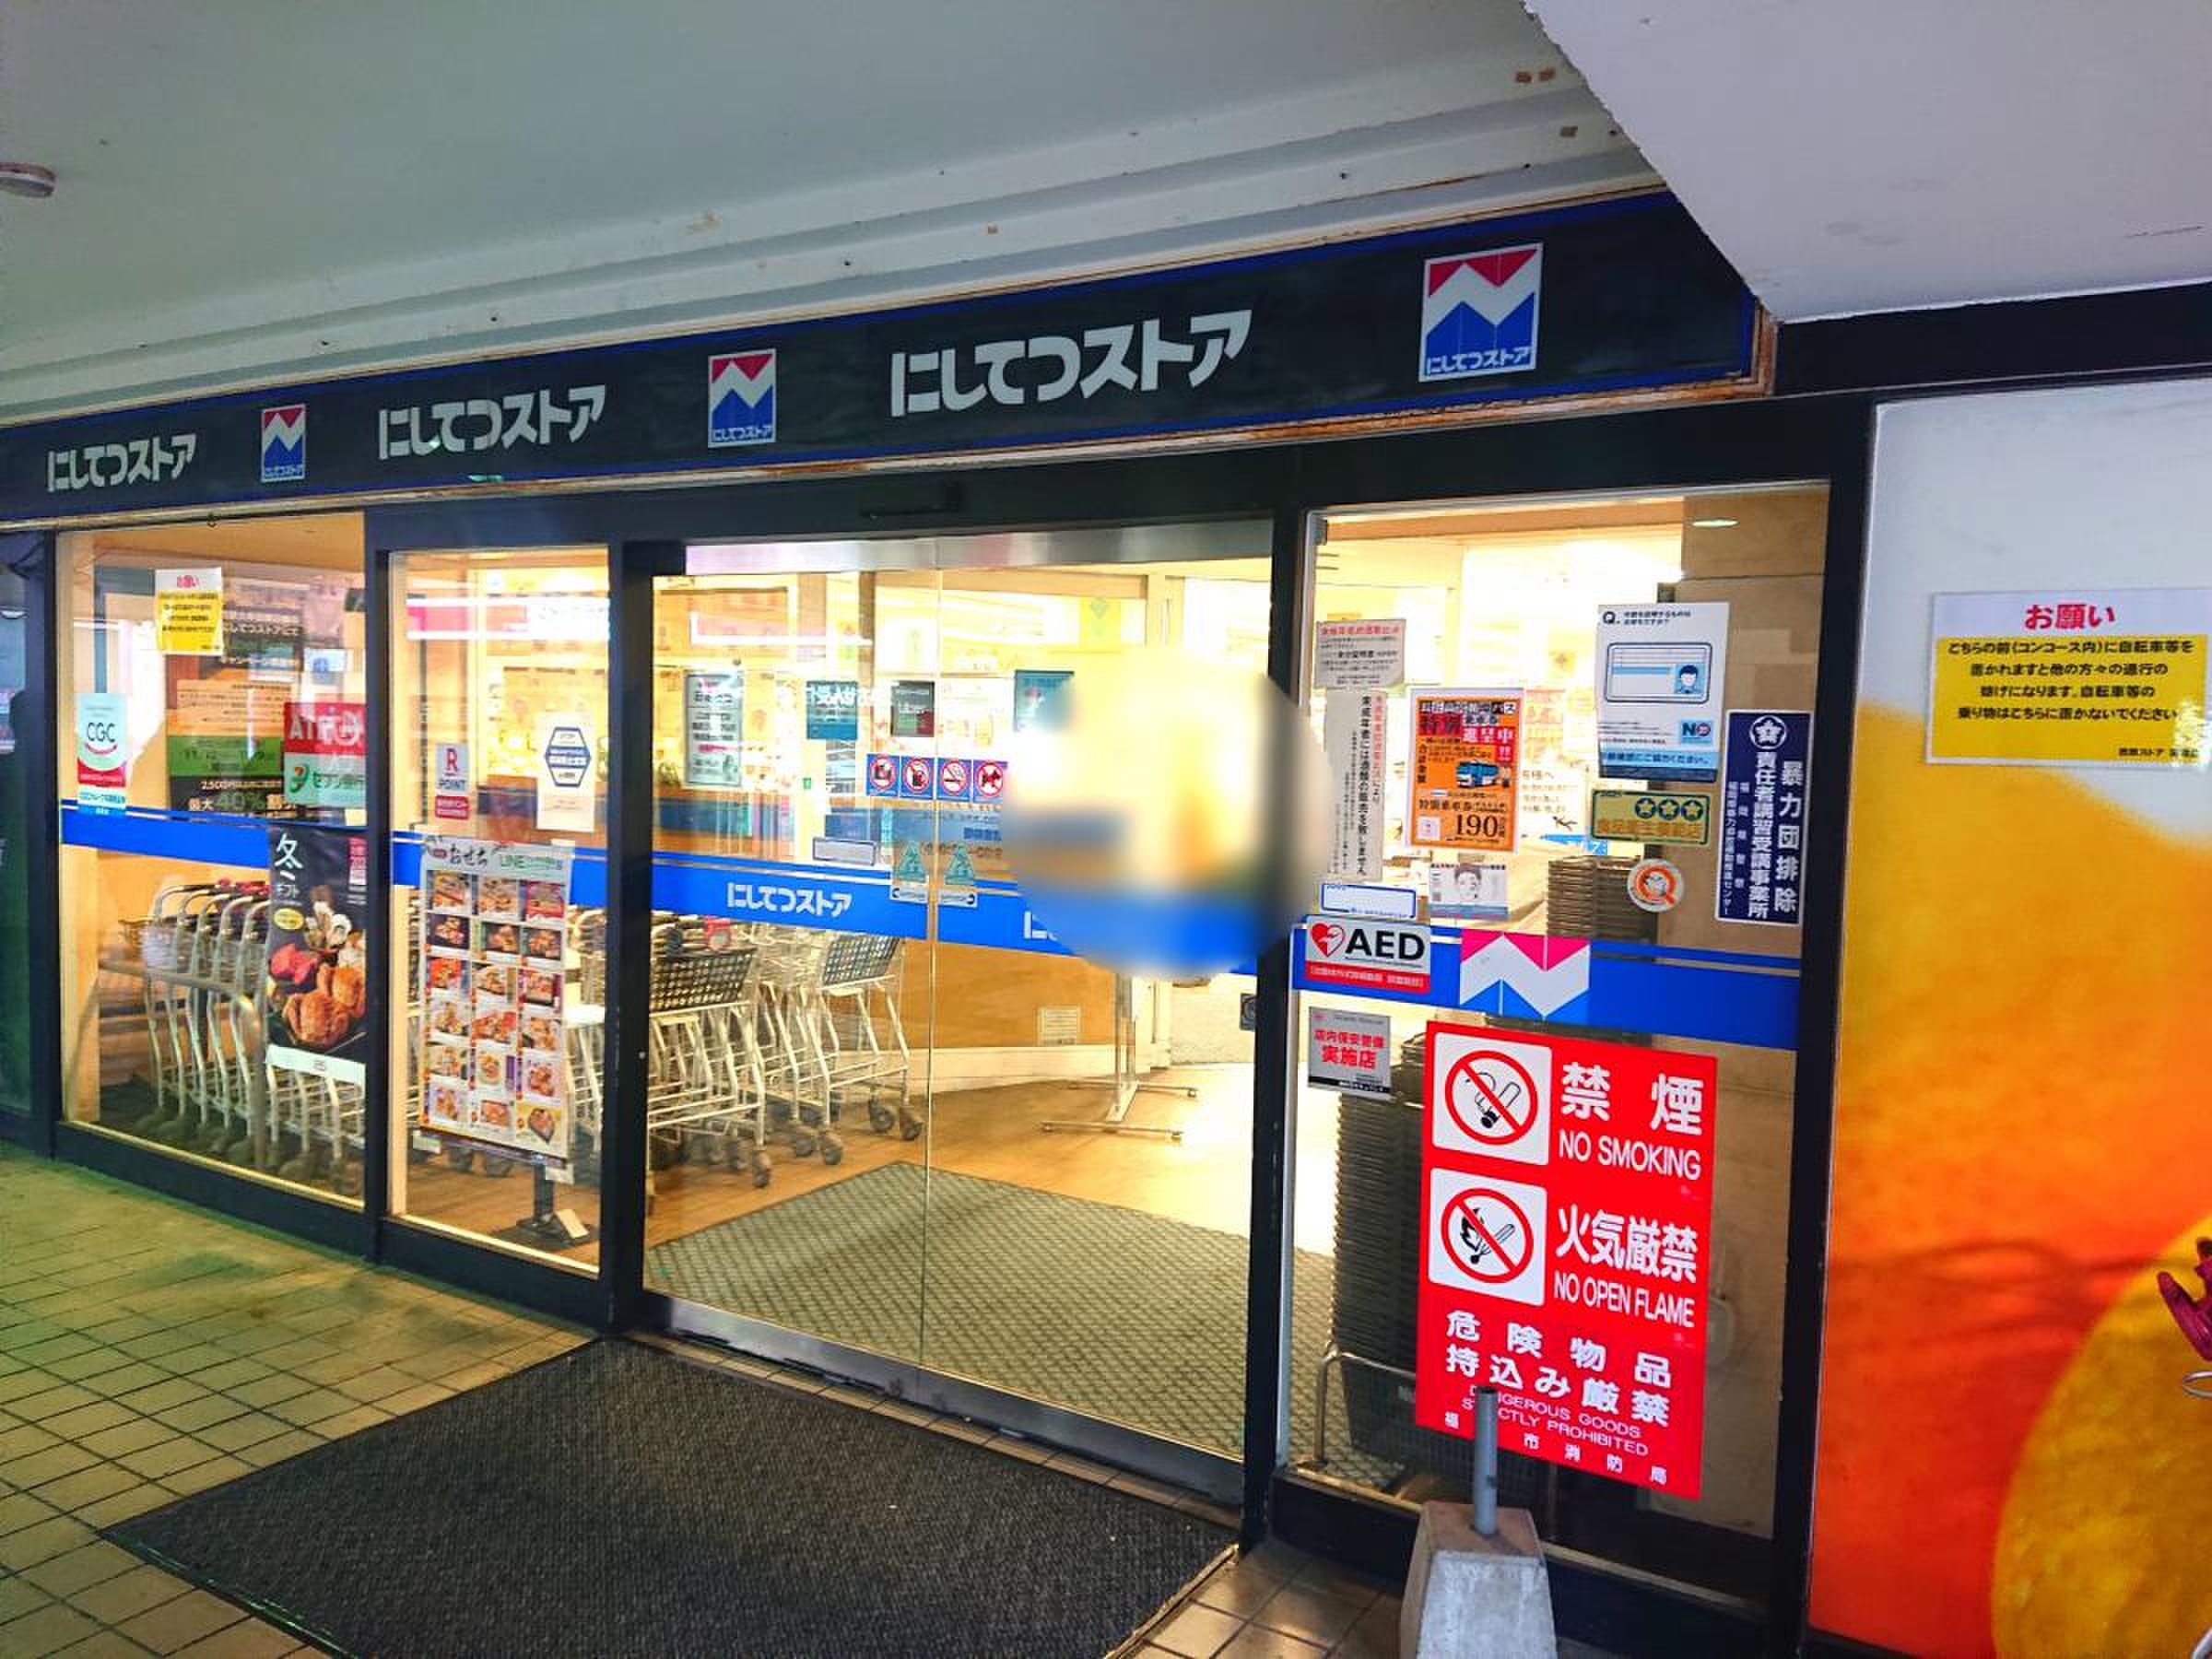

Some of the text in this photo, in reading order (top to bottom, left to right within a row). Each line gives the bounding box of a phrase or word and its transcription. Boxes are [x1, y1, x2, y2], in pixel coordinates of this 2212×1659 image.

[891, 310, 1252, 418] にしてつストア
[1426, 346, 1532, 374] にしてつストア
[379, 384, 606, 460] にしてつストア
[47, 433, 196, 492] にしてつストア
[2024, 604, 2116, 630] お願い
[87, 723, 116, 743] CGC
[438, 778, 466, 792] POINT
[1457, 813, 1498, 838] 190
[1774, 760, 1804, 912] 暴力団排除
[727, 882, 852, 917] にしてつストア
[1345, 929, 1425, 960] AED
[1561, 1062, 1703, 1135] 禁煙
[1559, 1130, 1701, 1181] NO SMOKING
[1556, 1203, 1698, 1284] 火気厳禁
[1553, 1269, 1695, 1327] NO OPEN FLAME
[1446, 1310, 1672, 1388] 危険物品
[1446, 1344, 1670, 1427] 持込み厳禁
[1469, 1385, 1642, 1439] DGEROUS GOODS
[1444, 1411, 1667, 1486] 福市消防局
[1462, 1397, 1650, 1457] SCTLY PROHIBITED
